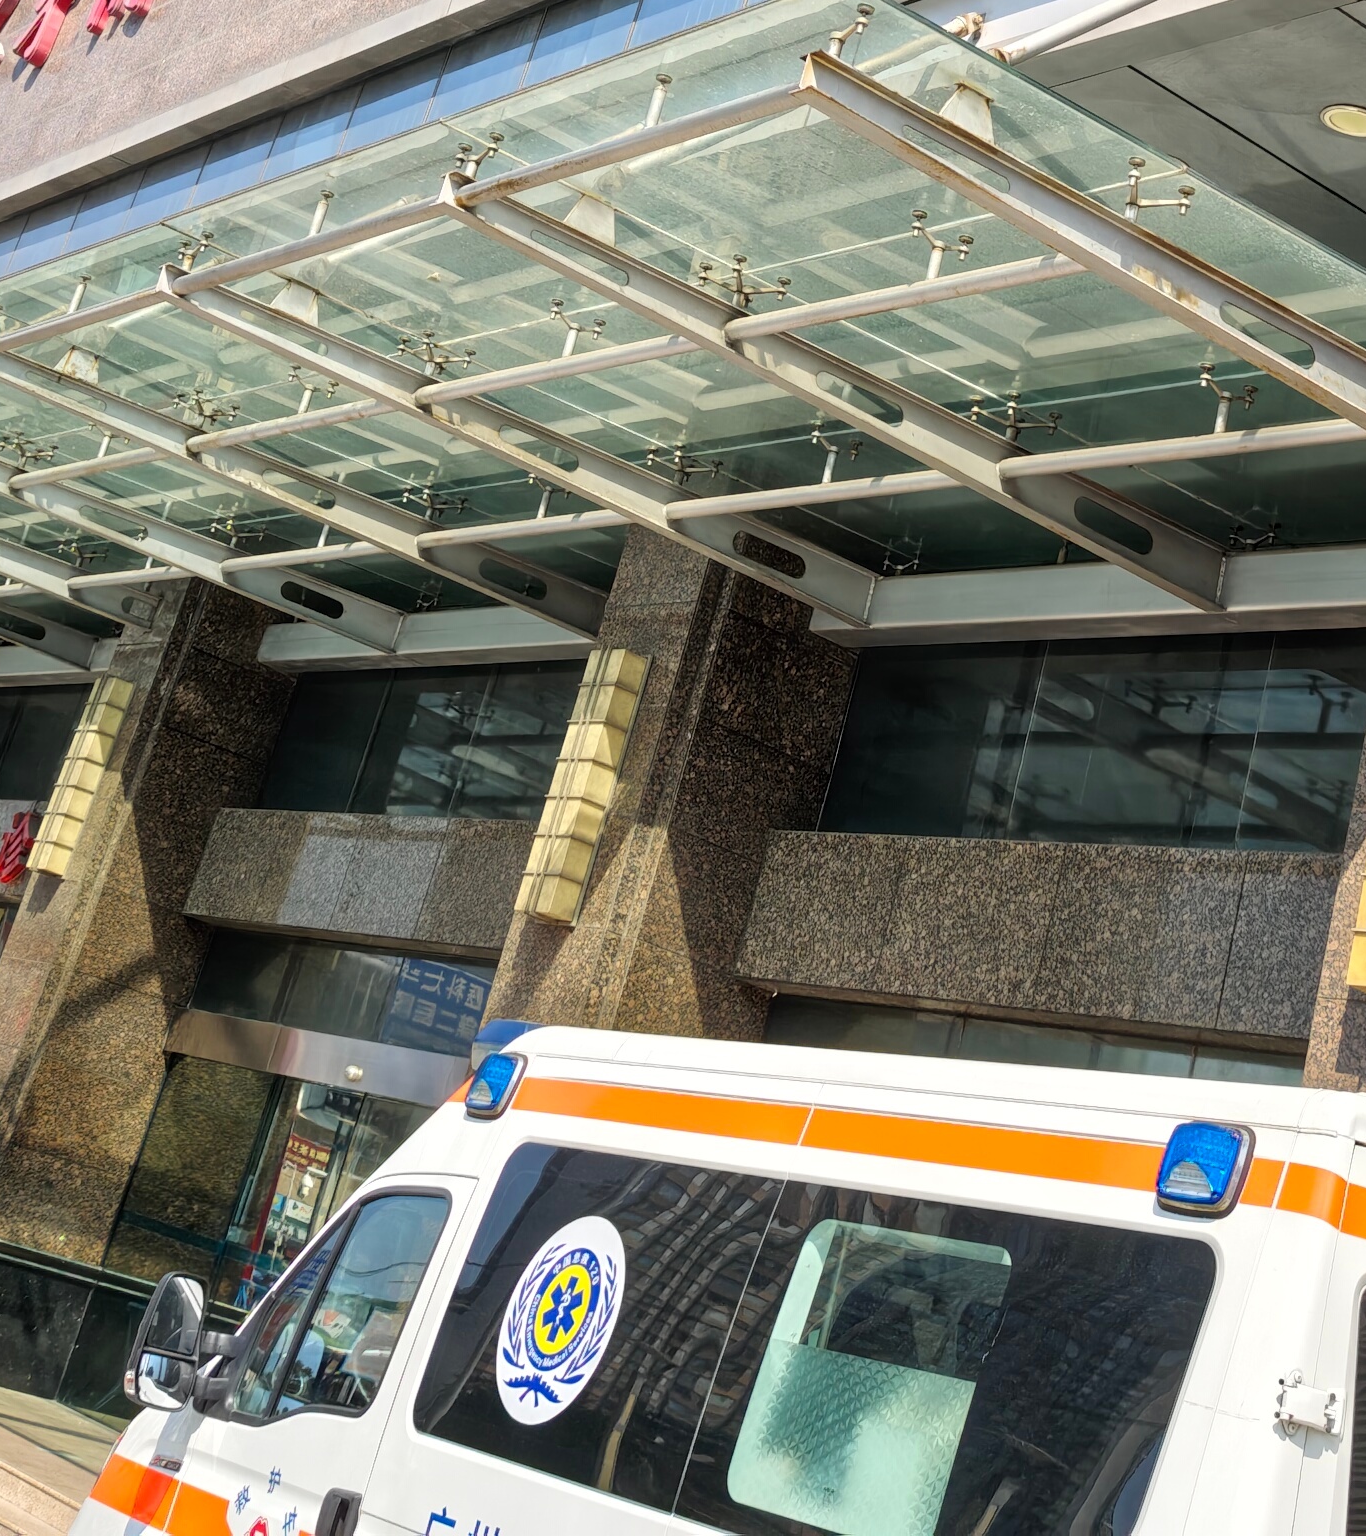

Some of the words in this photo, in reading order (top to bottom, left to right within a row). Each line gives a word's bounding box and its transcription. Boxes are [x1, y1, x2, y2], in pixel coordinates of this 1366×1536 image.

[528, 1293, 542, 1327] China
[542, 1350, 568, 1367] Medical
[568, 1311, 594, 1353] Services
